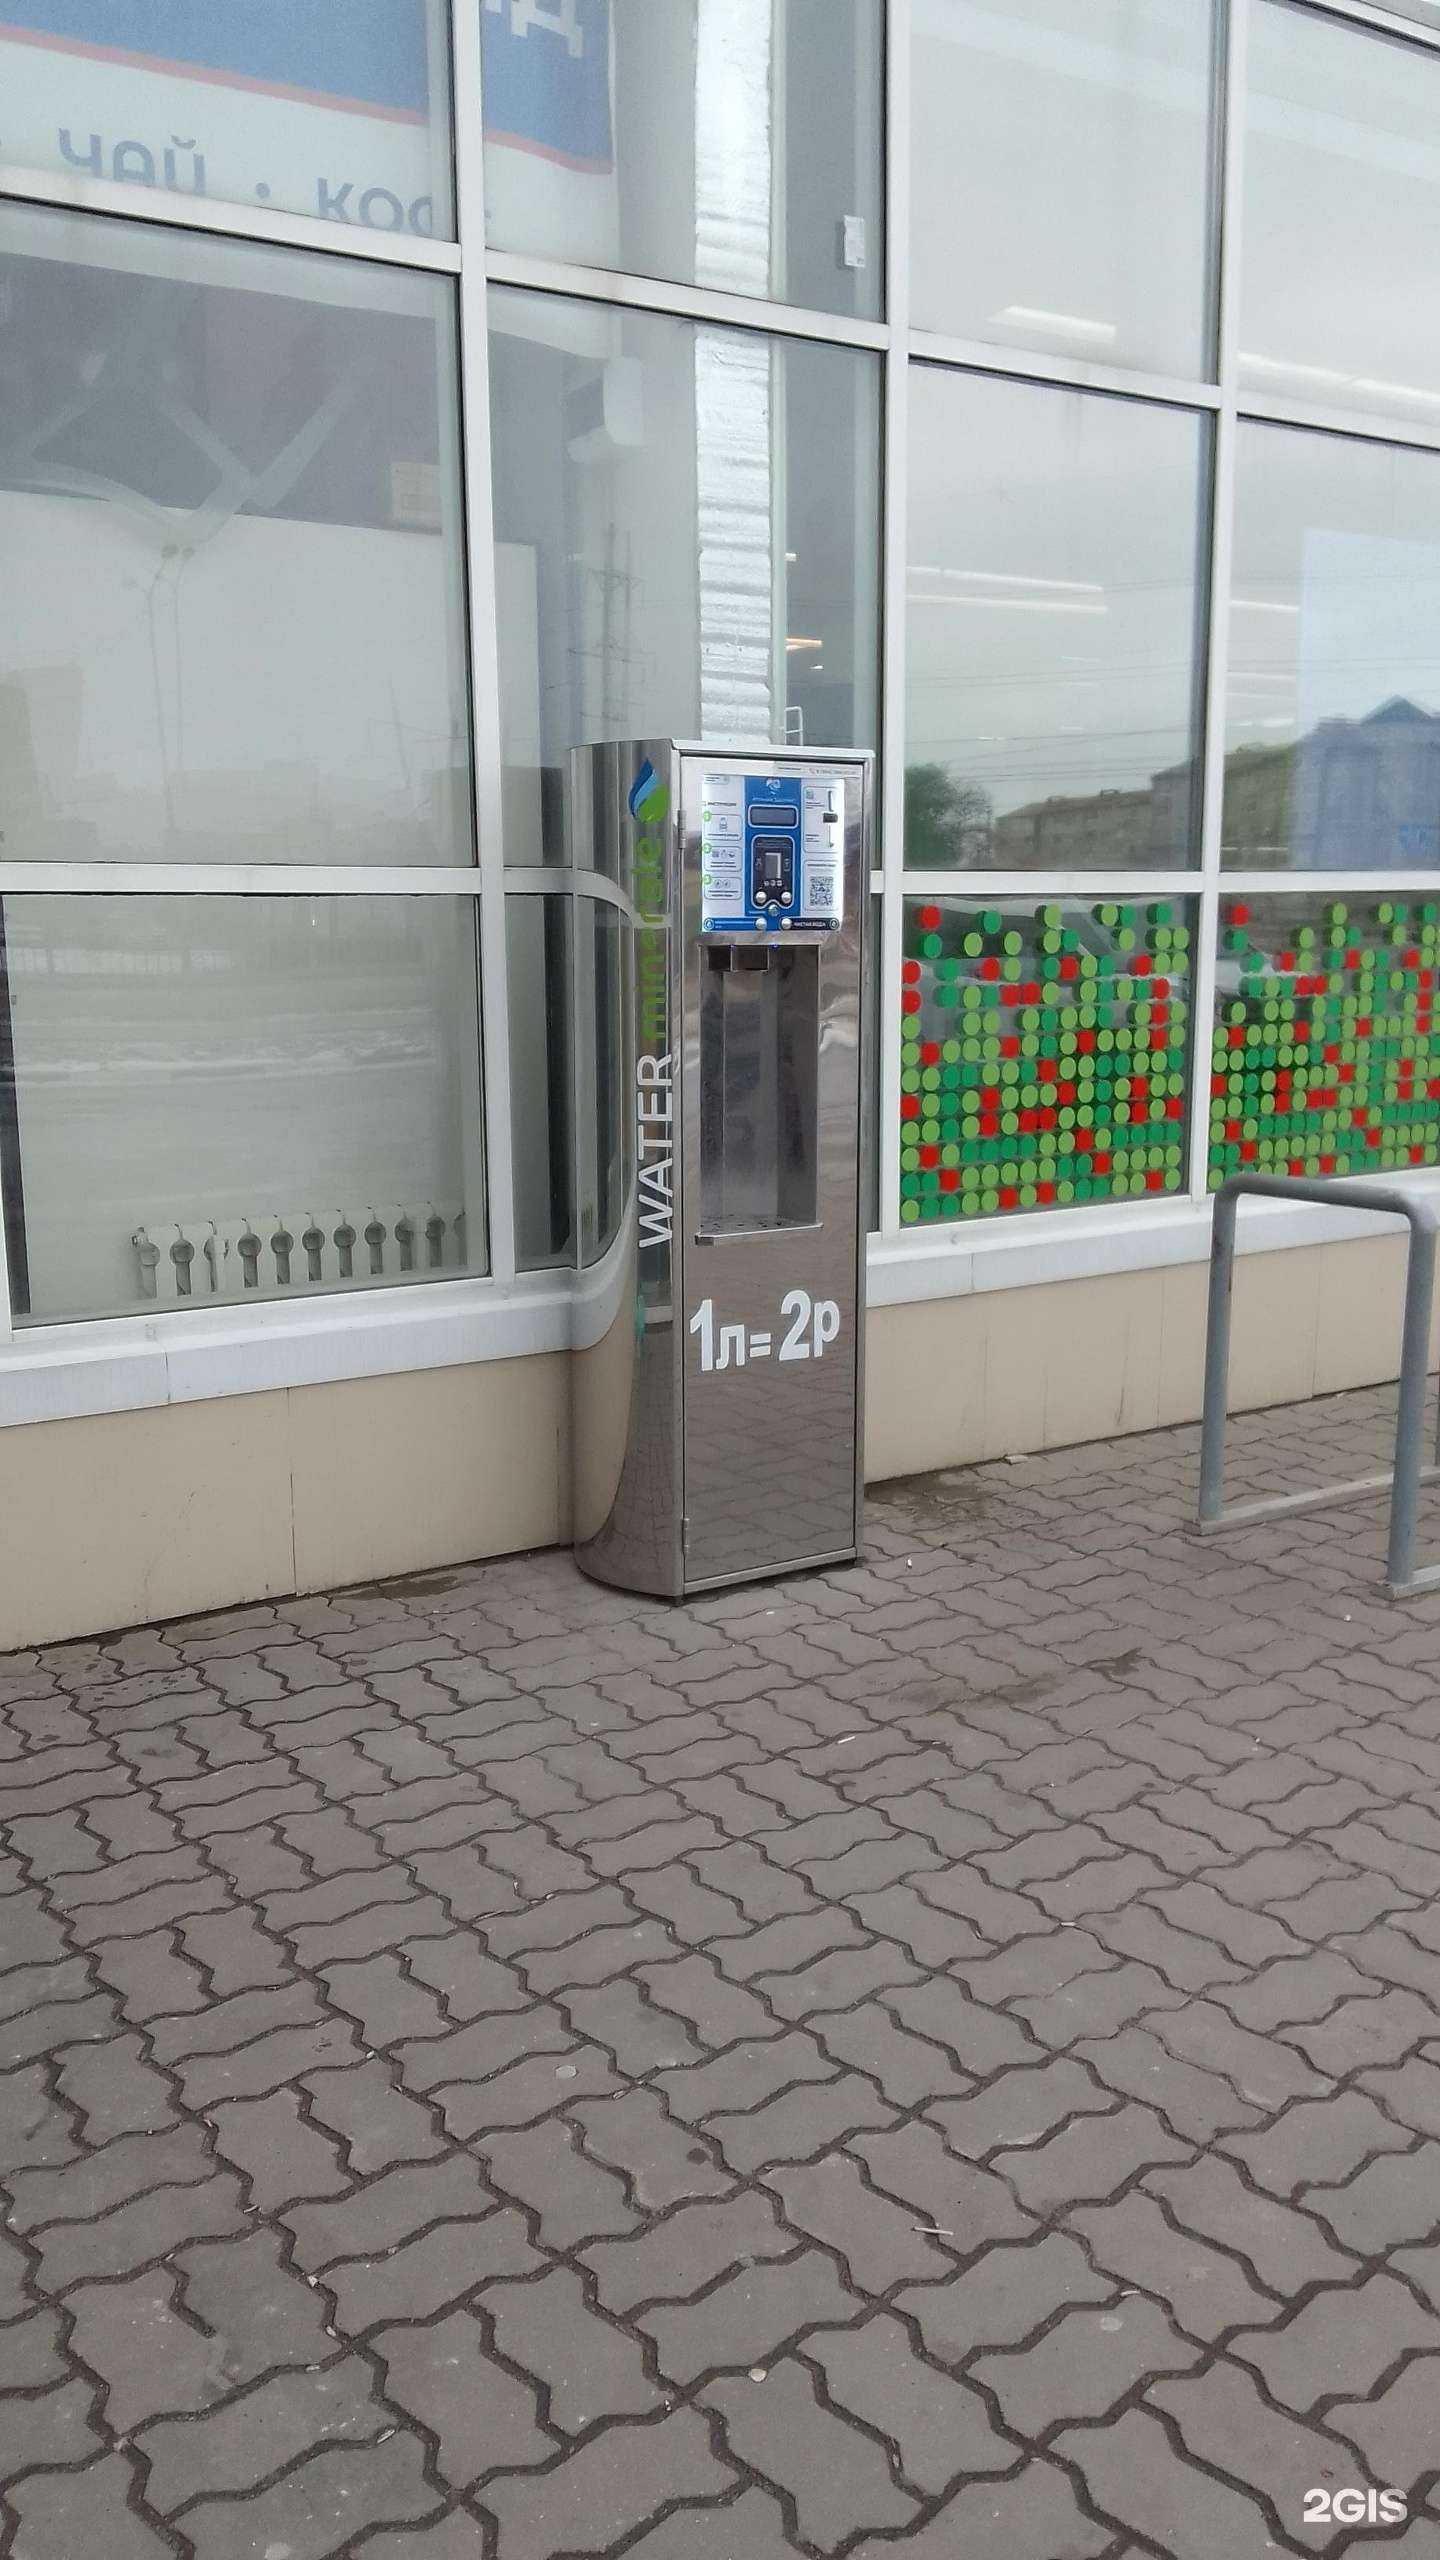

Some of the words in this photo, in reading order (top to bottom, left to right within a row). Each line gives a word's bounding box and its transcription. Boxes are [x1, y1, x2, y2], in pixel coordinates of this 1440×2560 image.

[58, 127, 206, 197] ЧАЙ
[630, 837, 666, 1040] minerale
[637, 1053, 674, 1249] WATER
